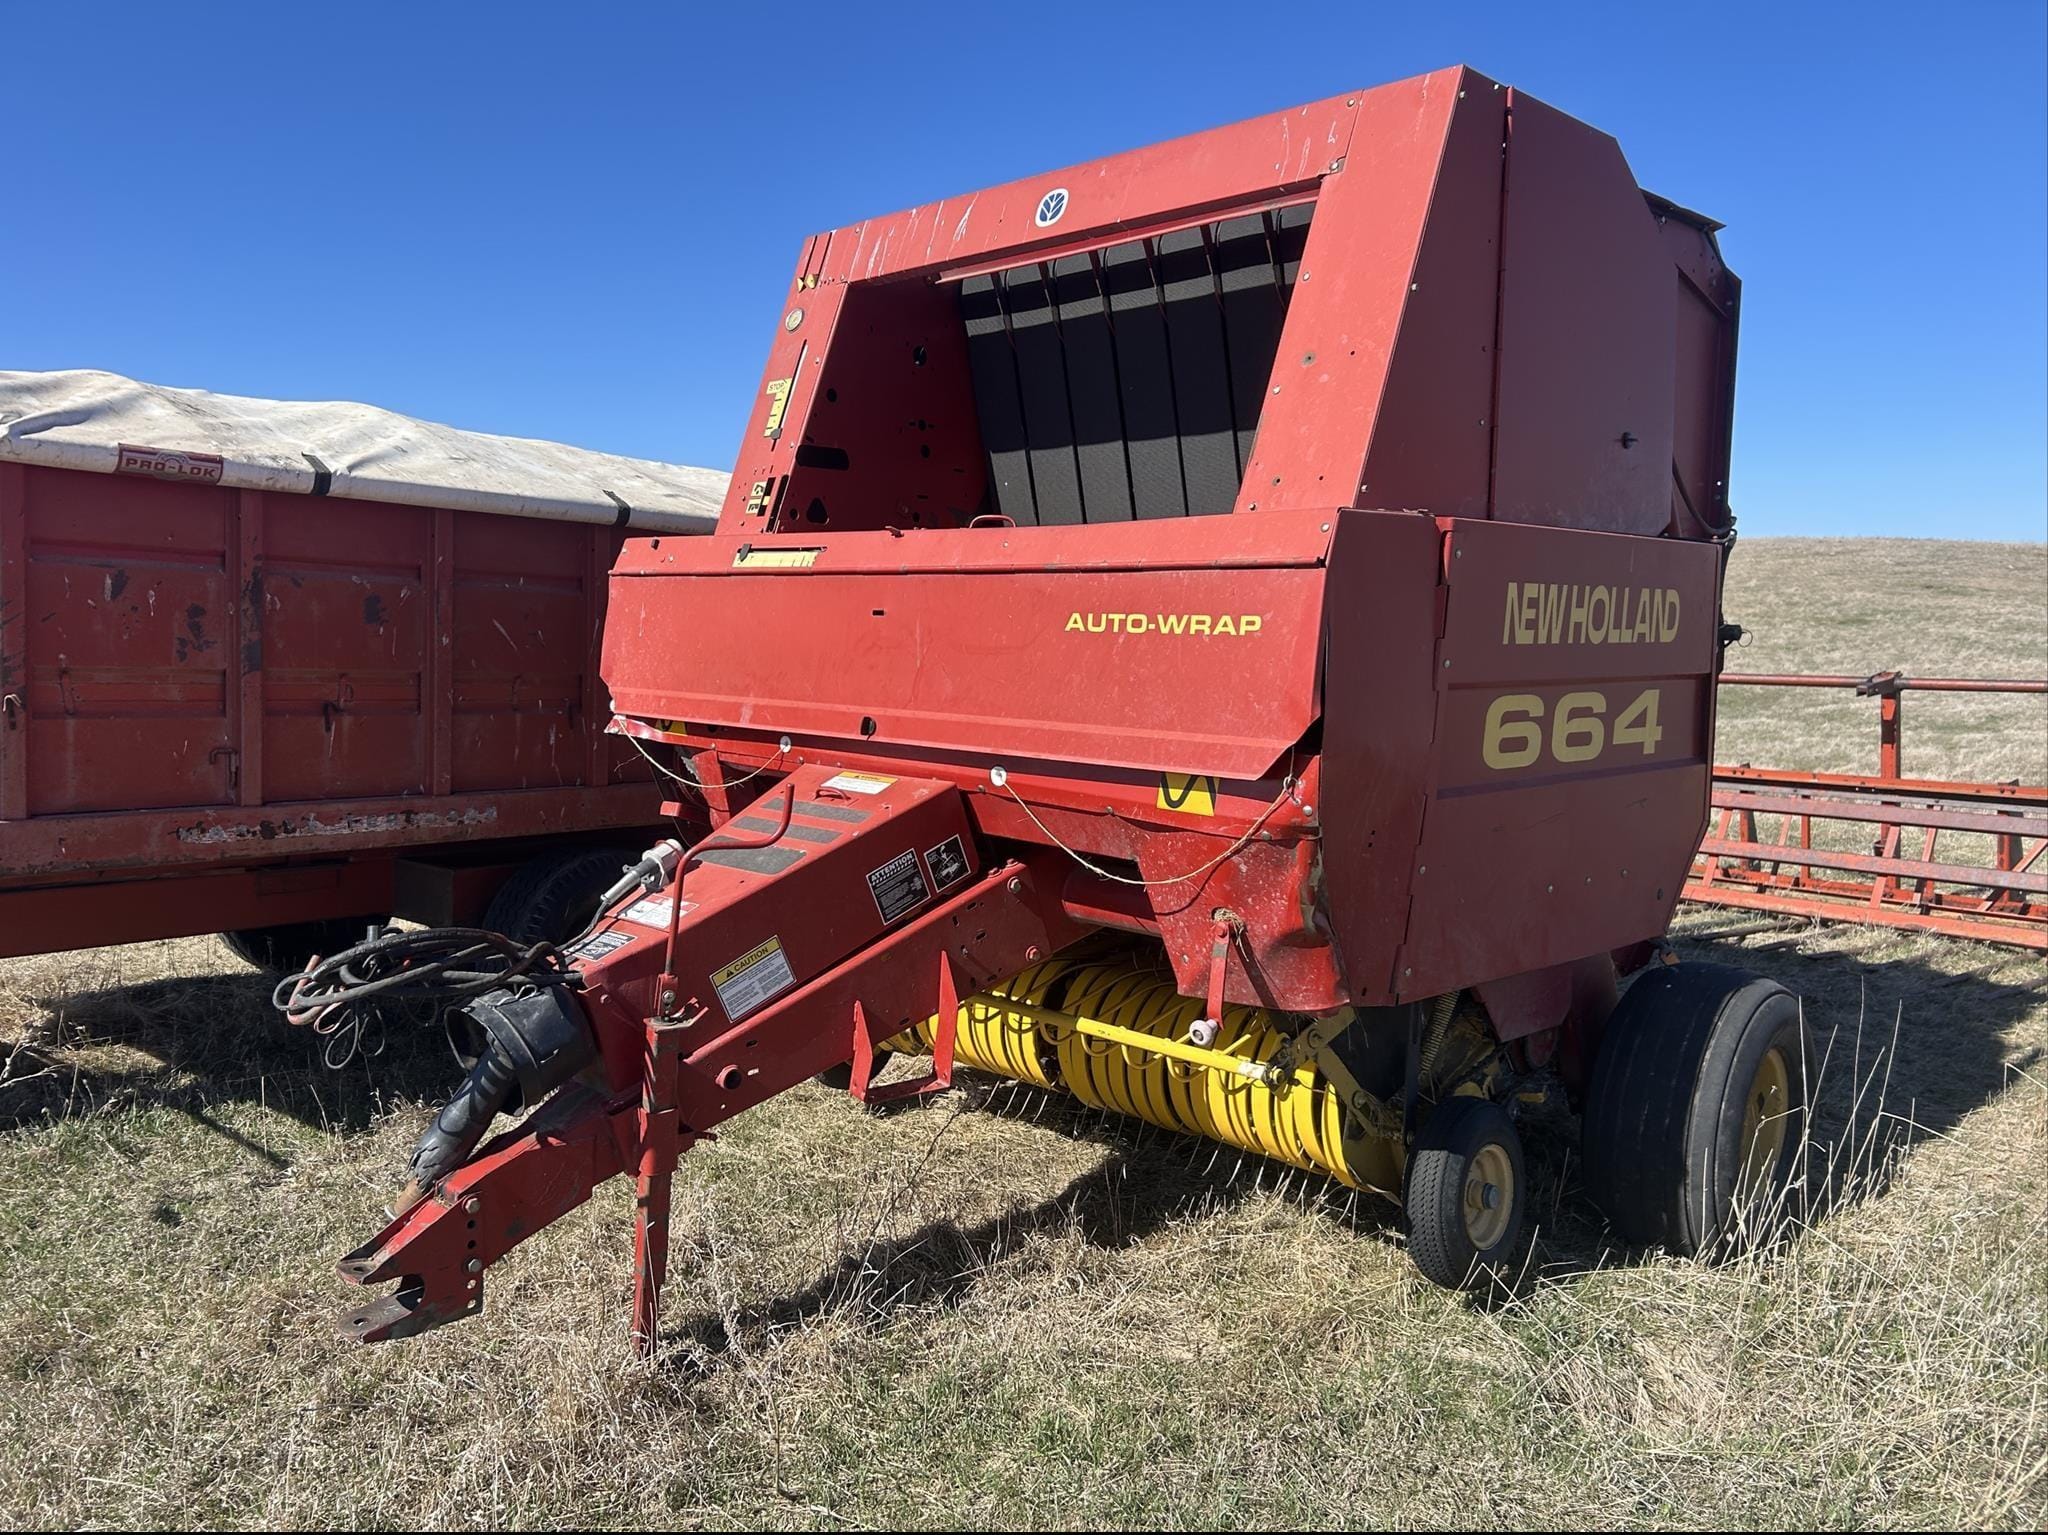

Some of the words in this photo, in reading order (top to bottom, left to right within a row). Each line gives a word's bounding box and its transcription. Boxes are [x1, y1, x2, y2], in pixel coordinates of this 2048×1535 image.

[125, 458, 216, 477] PRO-LOK
[1064, 612, 1262, 636] AUTO-WRAP
[1502, 582, 1568, 645] NEW
[1567, 585, 1681, 644] HOLLAND
[1482, 689, 1663, 770] 664
[871, 852, 913, 882] ATTENTION
[734, 946, 769, 972] CAUTION
